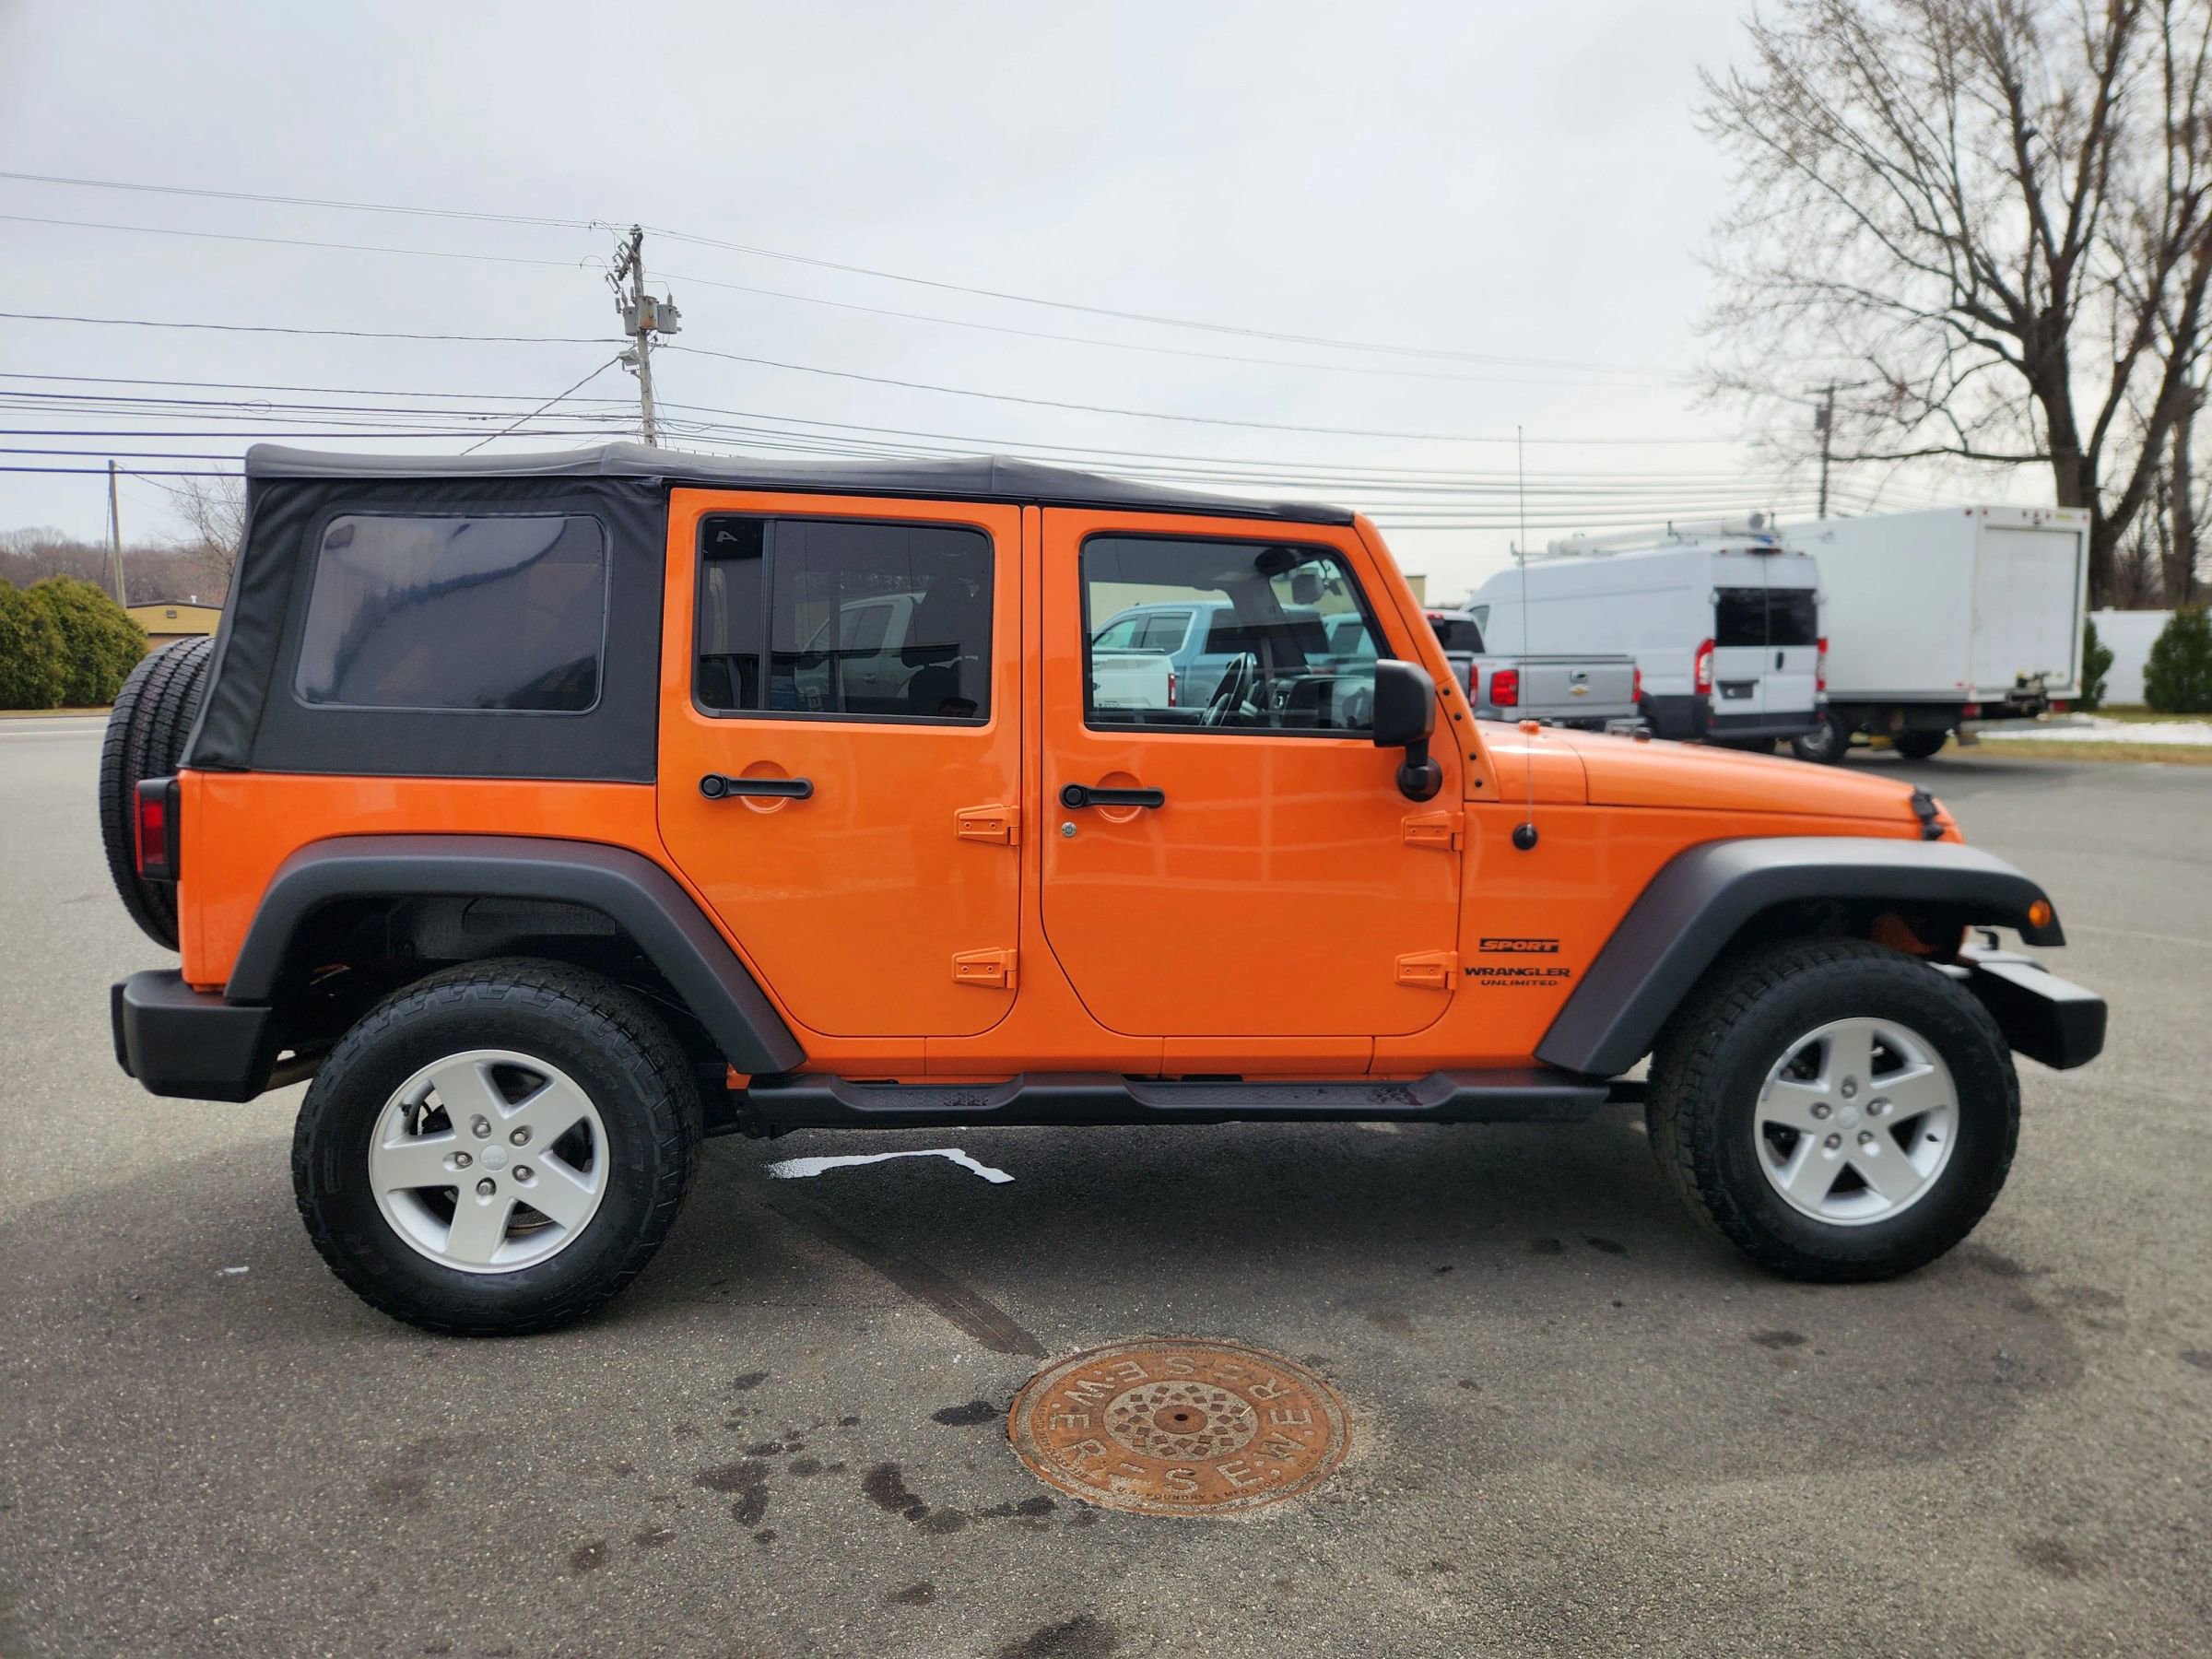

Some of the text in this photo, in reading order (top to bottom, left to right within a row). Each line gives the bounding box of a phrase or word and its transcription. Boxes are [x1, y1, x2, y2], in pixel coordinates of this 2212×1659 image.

[1480, 939, 1558, 952] SPORT
[1465, 967, 1571, 977] WRANGLER
[1146, 1492, 1206, 1501] FOUNDRY
